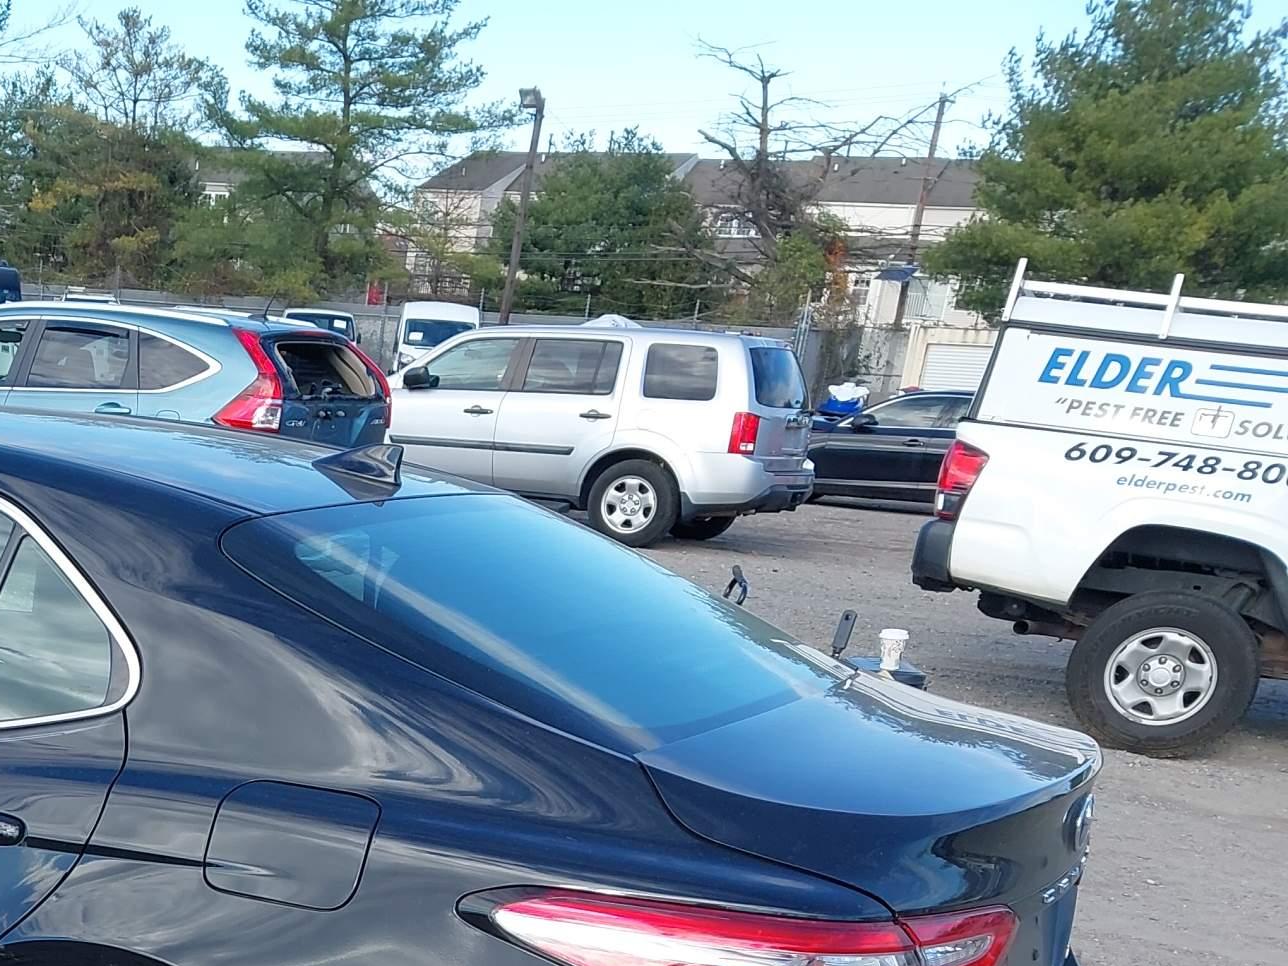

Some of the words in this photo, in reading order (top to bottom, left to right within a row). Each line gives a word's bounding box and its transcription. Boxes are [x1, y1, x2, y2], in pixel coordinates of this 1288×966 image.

[1038, 347, 1194, 399] ELDER
[1128, 407, 1185, 428] FREE
[1234, 419, 1288, 441] SOL
[1064, 442, 1288, 485] 609-748-80
[1116, 473, 1253, 503] elderpest.com
